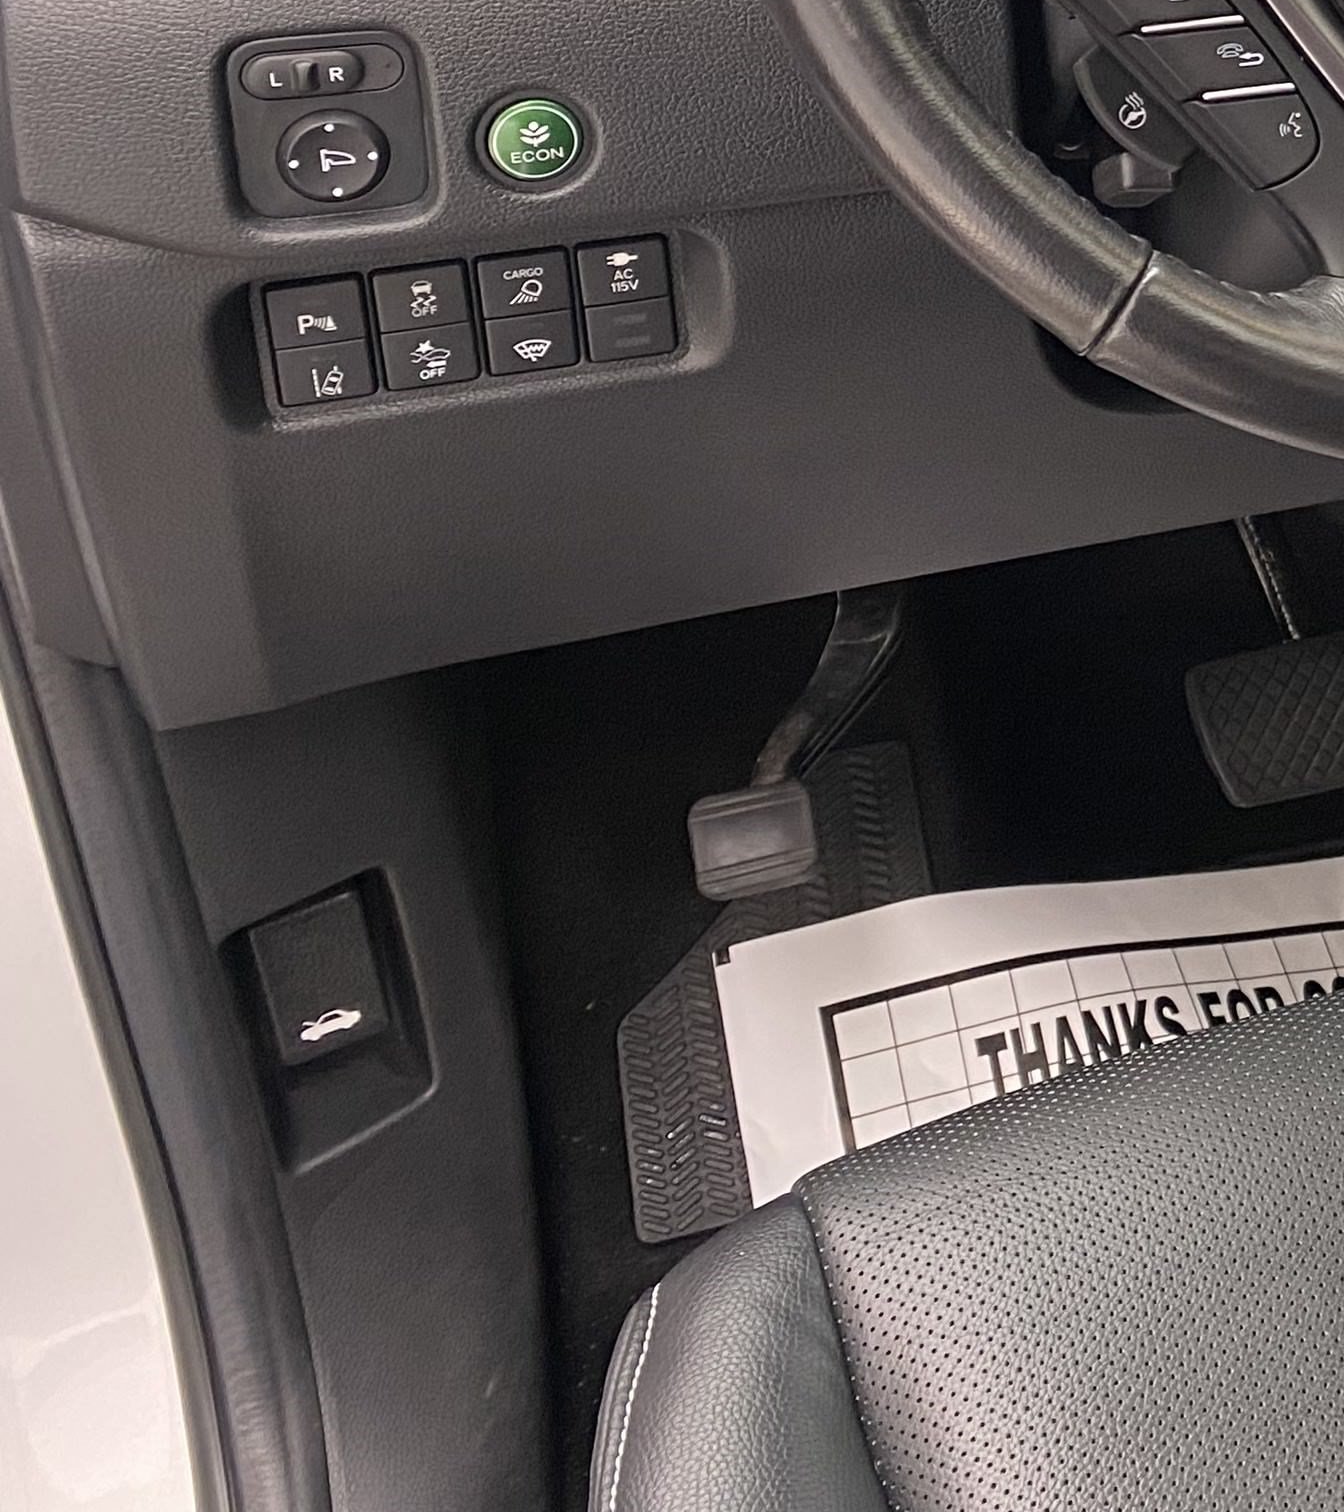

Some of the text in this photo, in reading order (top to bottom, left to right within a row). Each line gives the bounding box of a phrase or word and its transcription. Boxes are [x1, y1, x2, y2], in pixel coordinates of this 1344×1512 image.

[270, 66, 344, 88] L R
[510, 146, 565, 165] ECON
[503, 266, 544, 281] CARGO
[613, 268, 633, 281] AC
[609, 279, 639, 293] 115V
[411, 304, 438, 318] OFF
[419, 366, 446, 380] OFF
[975, 995, 1188, 1095] THANKS
